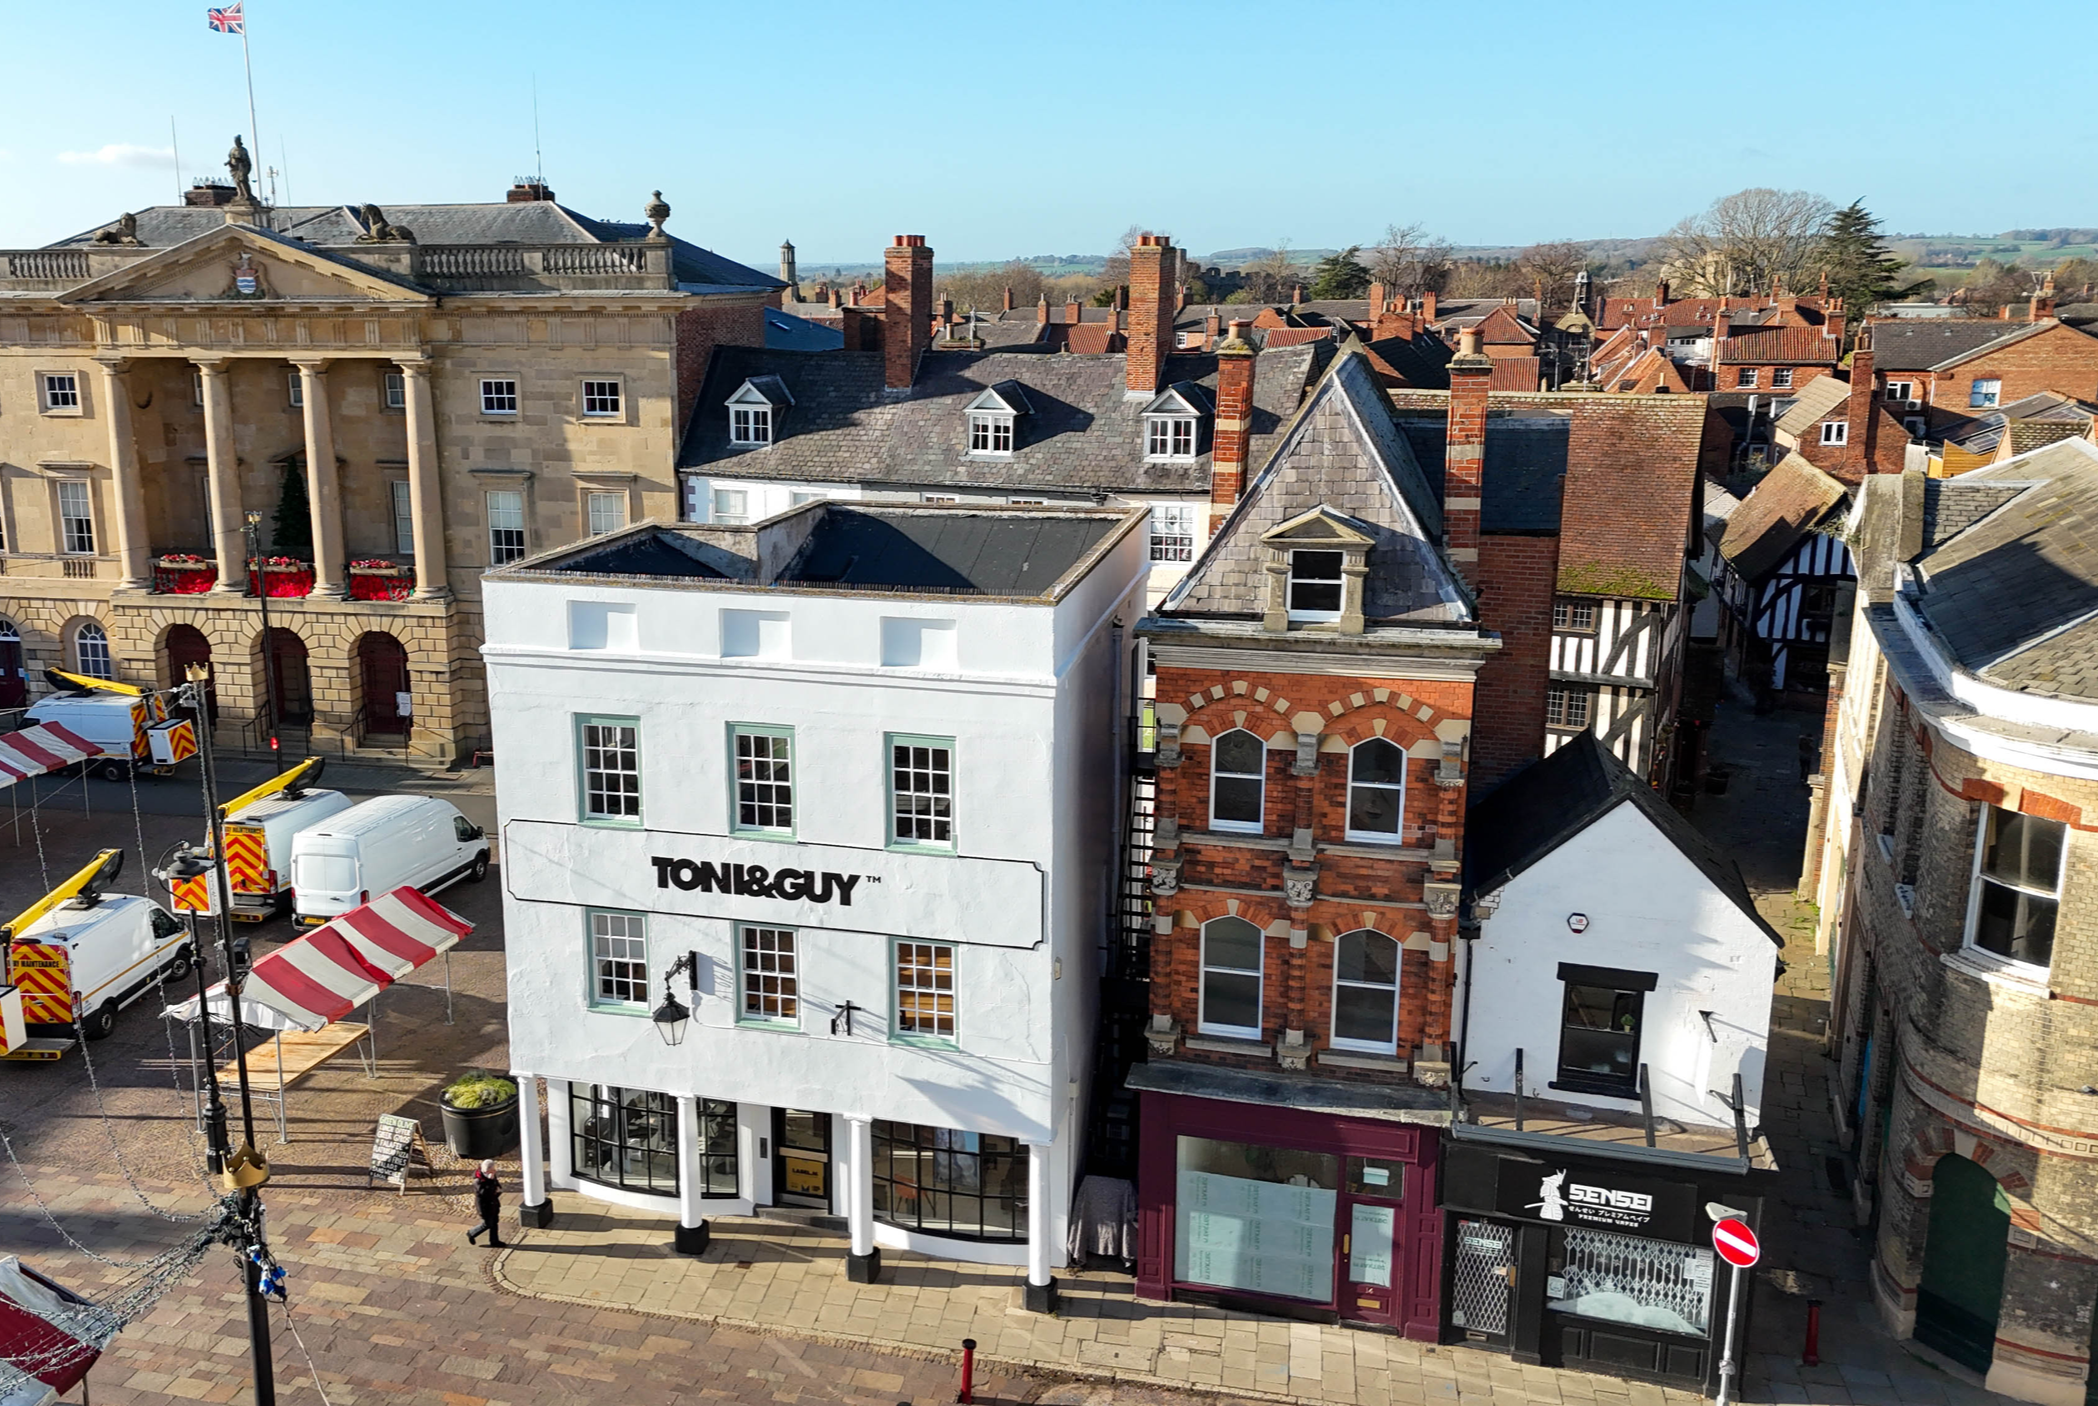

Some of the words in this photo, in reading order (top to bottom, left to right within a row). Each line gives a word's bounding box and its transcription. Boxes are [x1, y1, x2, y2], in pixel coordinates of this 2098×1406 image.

[651, 855, 861, 906] TONI&GUY
[21, 960, 59, 968] MAINTENANCE
[1568, 1183, 1653, 1212] SENSEI
[1578, 1213, 1613, 1224] PREMIUM
[1614, 1219, 1639, 1228] VAPES
